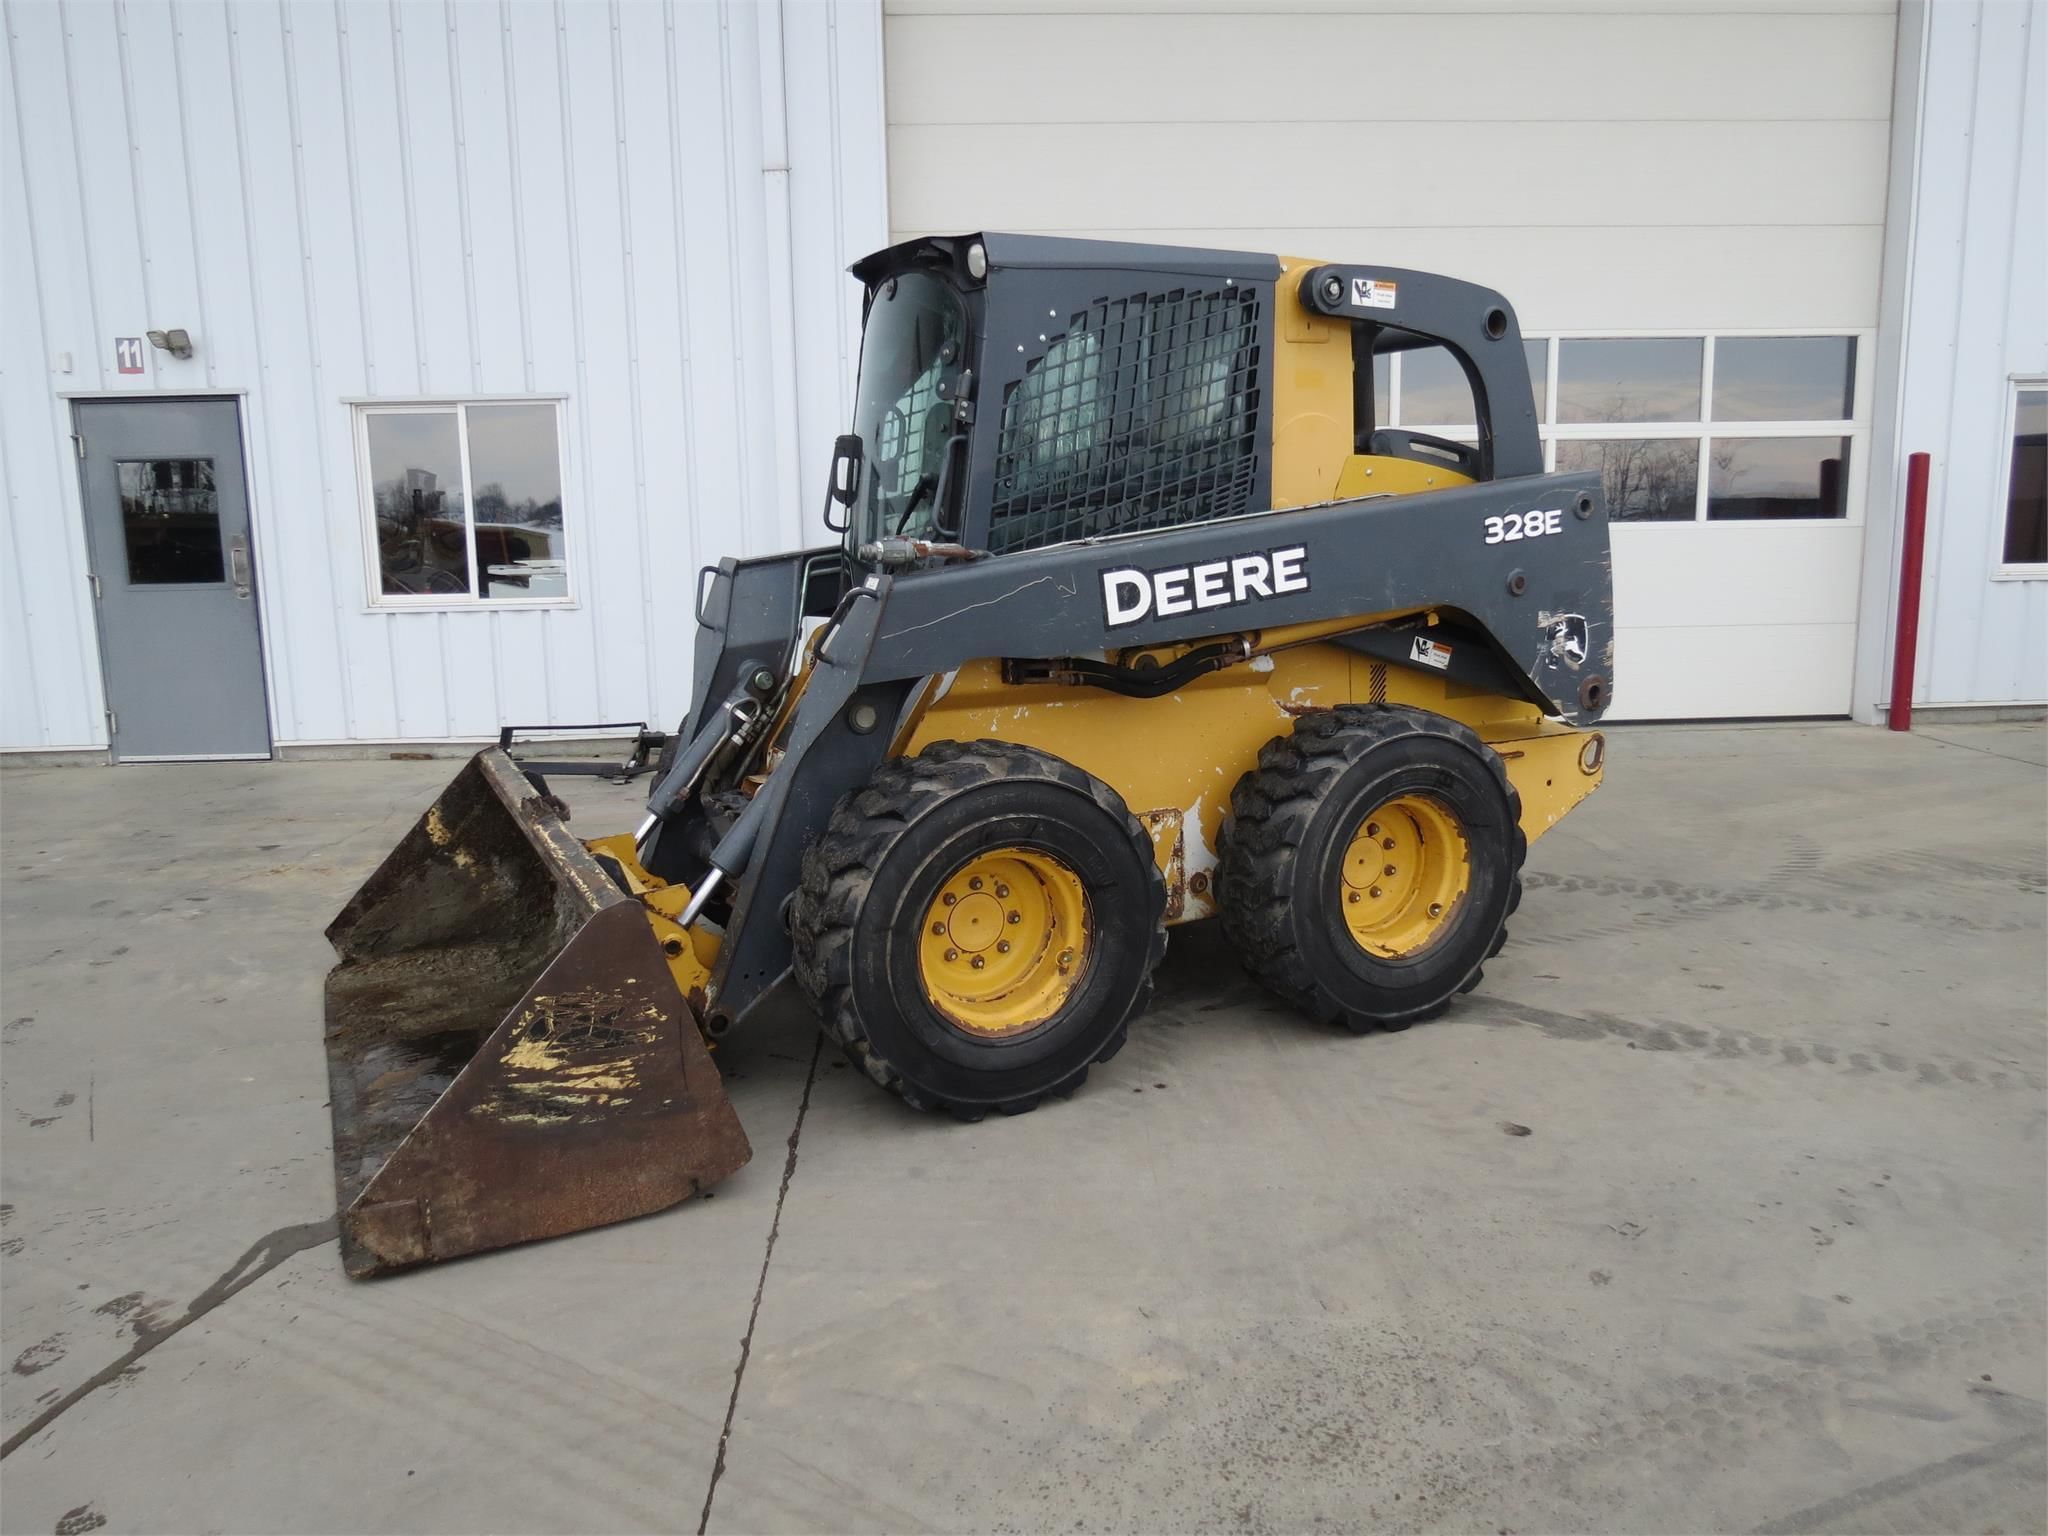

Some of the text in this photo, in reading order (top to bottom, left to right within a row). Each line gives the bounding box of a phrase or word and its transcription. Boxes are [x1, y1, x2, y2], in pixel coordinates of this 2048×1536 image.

[119, 340, 142, 368] 11
[1484, 509, 1562, 544] 328E
[1103, 547, 1308, 626] DEERE
